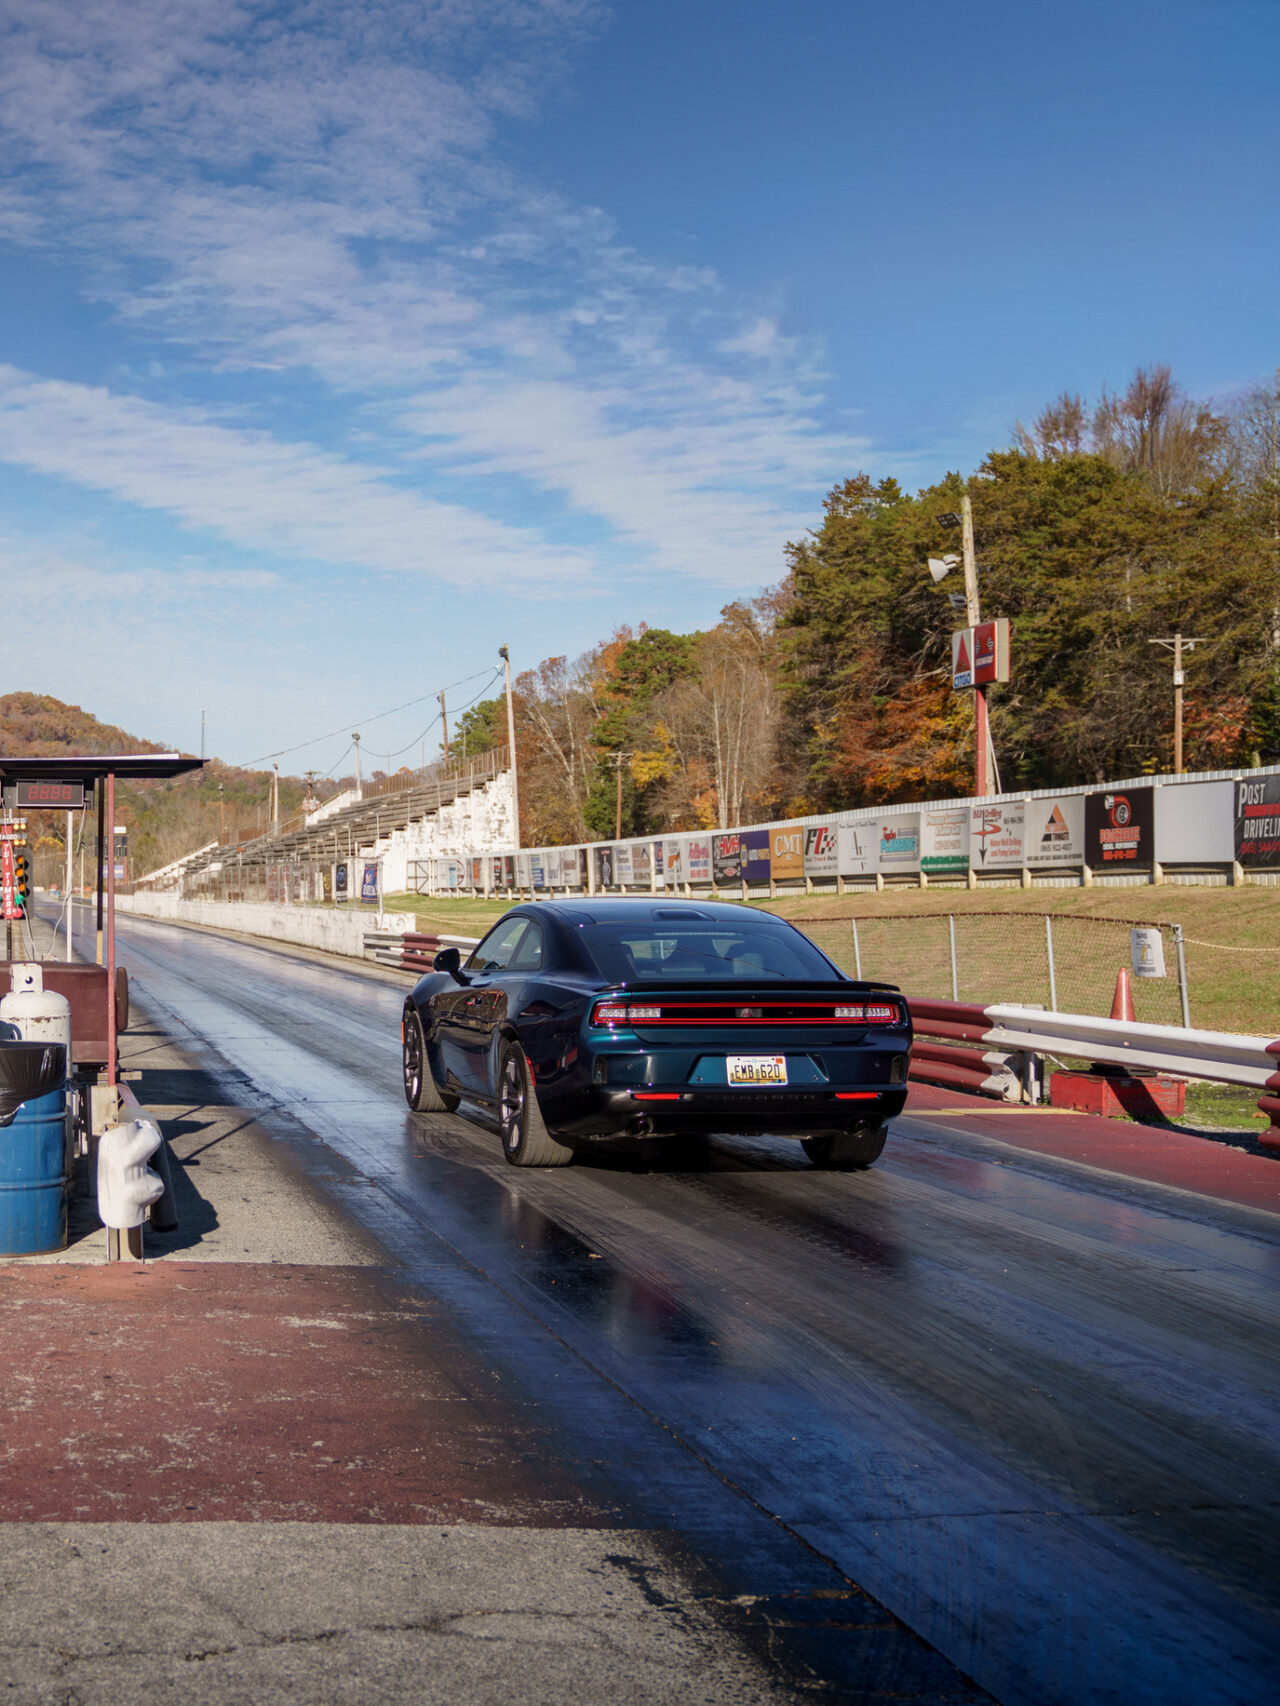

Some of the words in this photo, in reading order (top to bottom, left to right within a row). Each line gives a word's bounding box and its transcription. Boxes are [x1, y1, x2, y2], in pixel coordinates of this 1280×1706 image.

[1238, 783, 1266, 817] POST
[1244, 818, 1280, 838] DRIVELI
[775, 834, 802, 857] CMT
[734, 1064, 754, 1079] EMB
